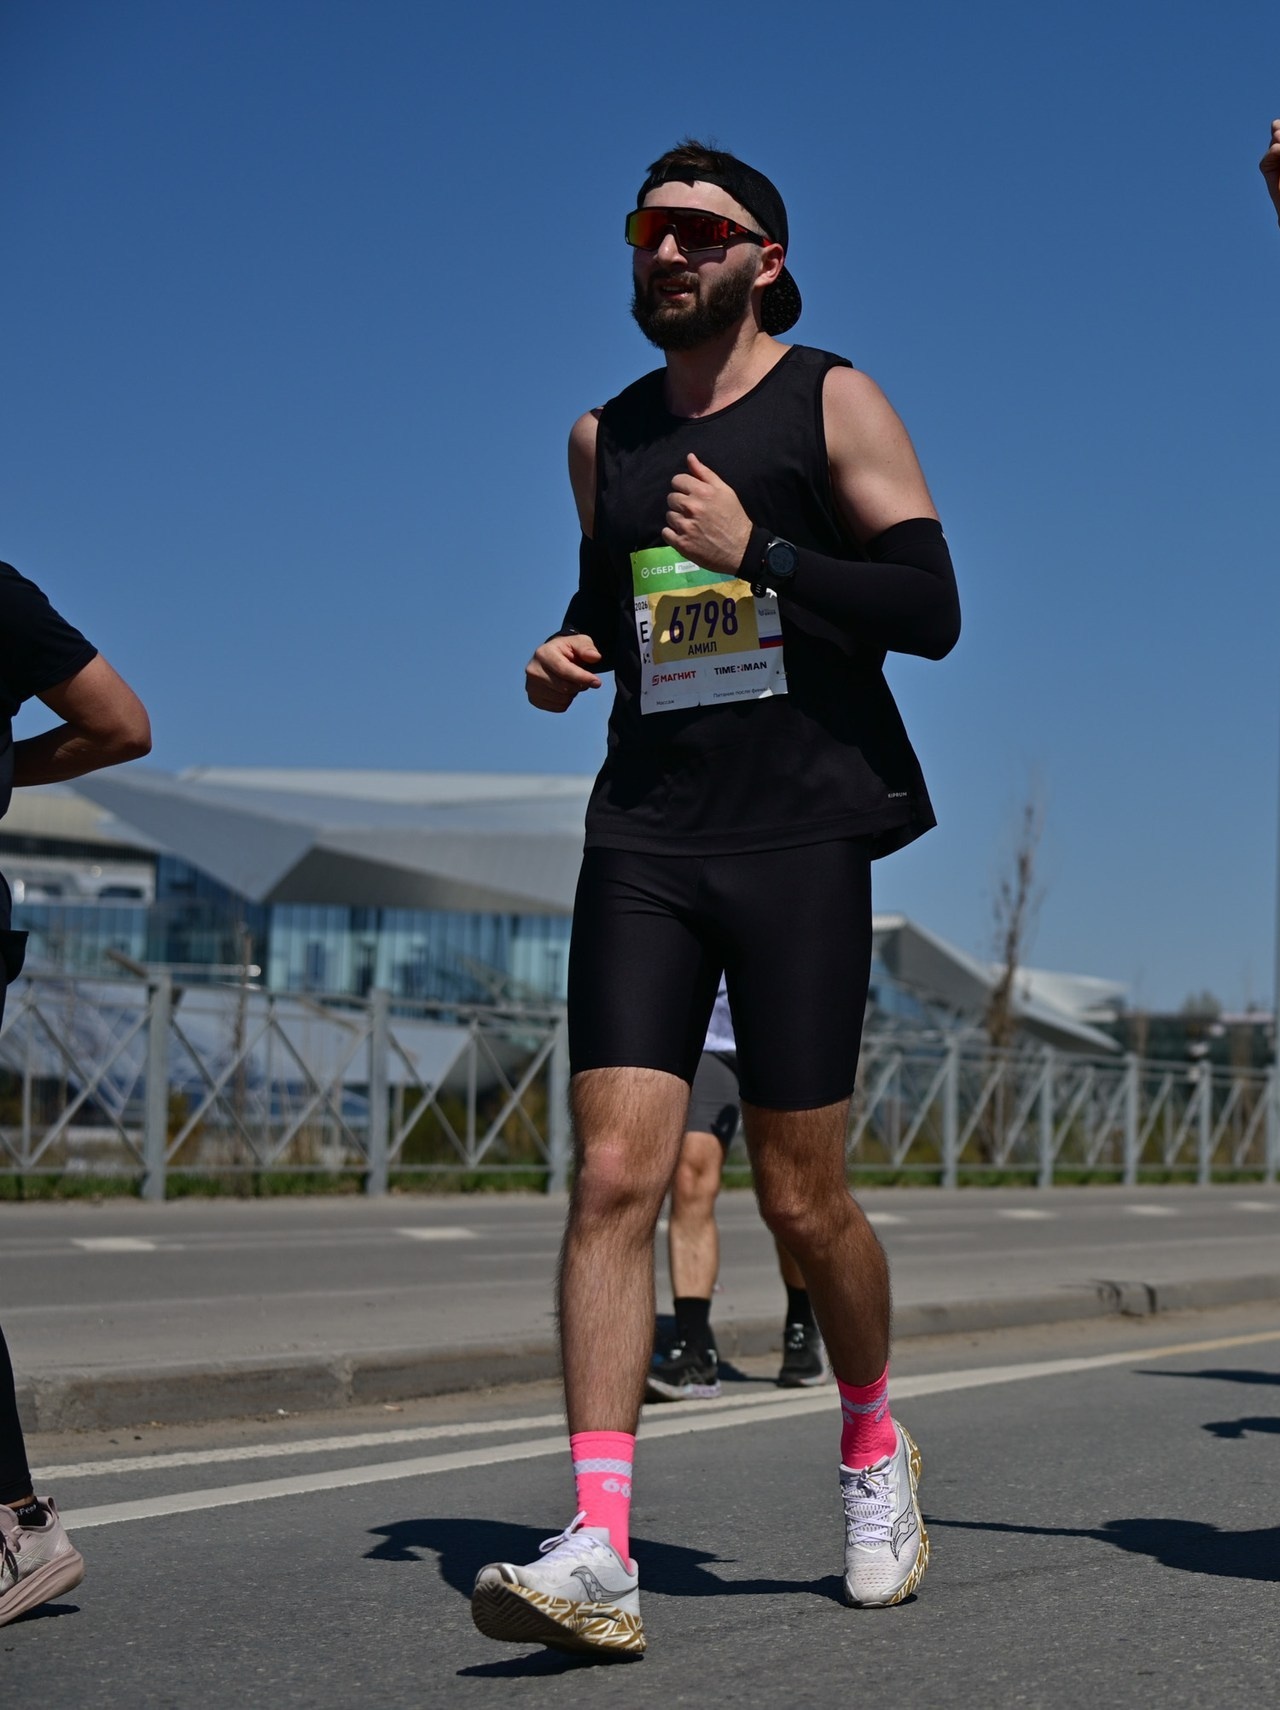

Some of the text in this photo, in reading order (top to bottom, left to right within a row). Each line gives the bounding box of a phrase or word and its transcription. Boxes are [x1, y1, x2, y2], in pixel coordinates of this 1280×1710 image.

[650, 565, 674, 575] СБЕР
[669, 597, 739, 644] 6798
[687, 641, 718, 656] АМИЛ
[660, 670, 697, 682] МАГНИТ
